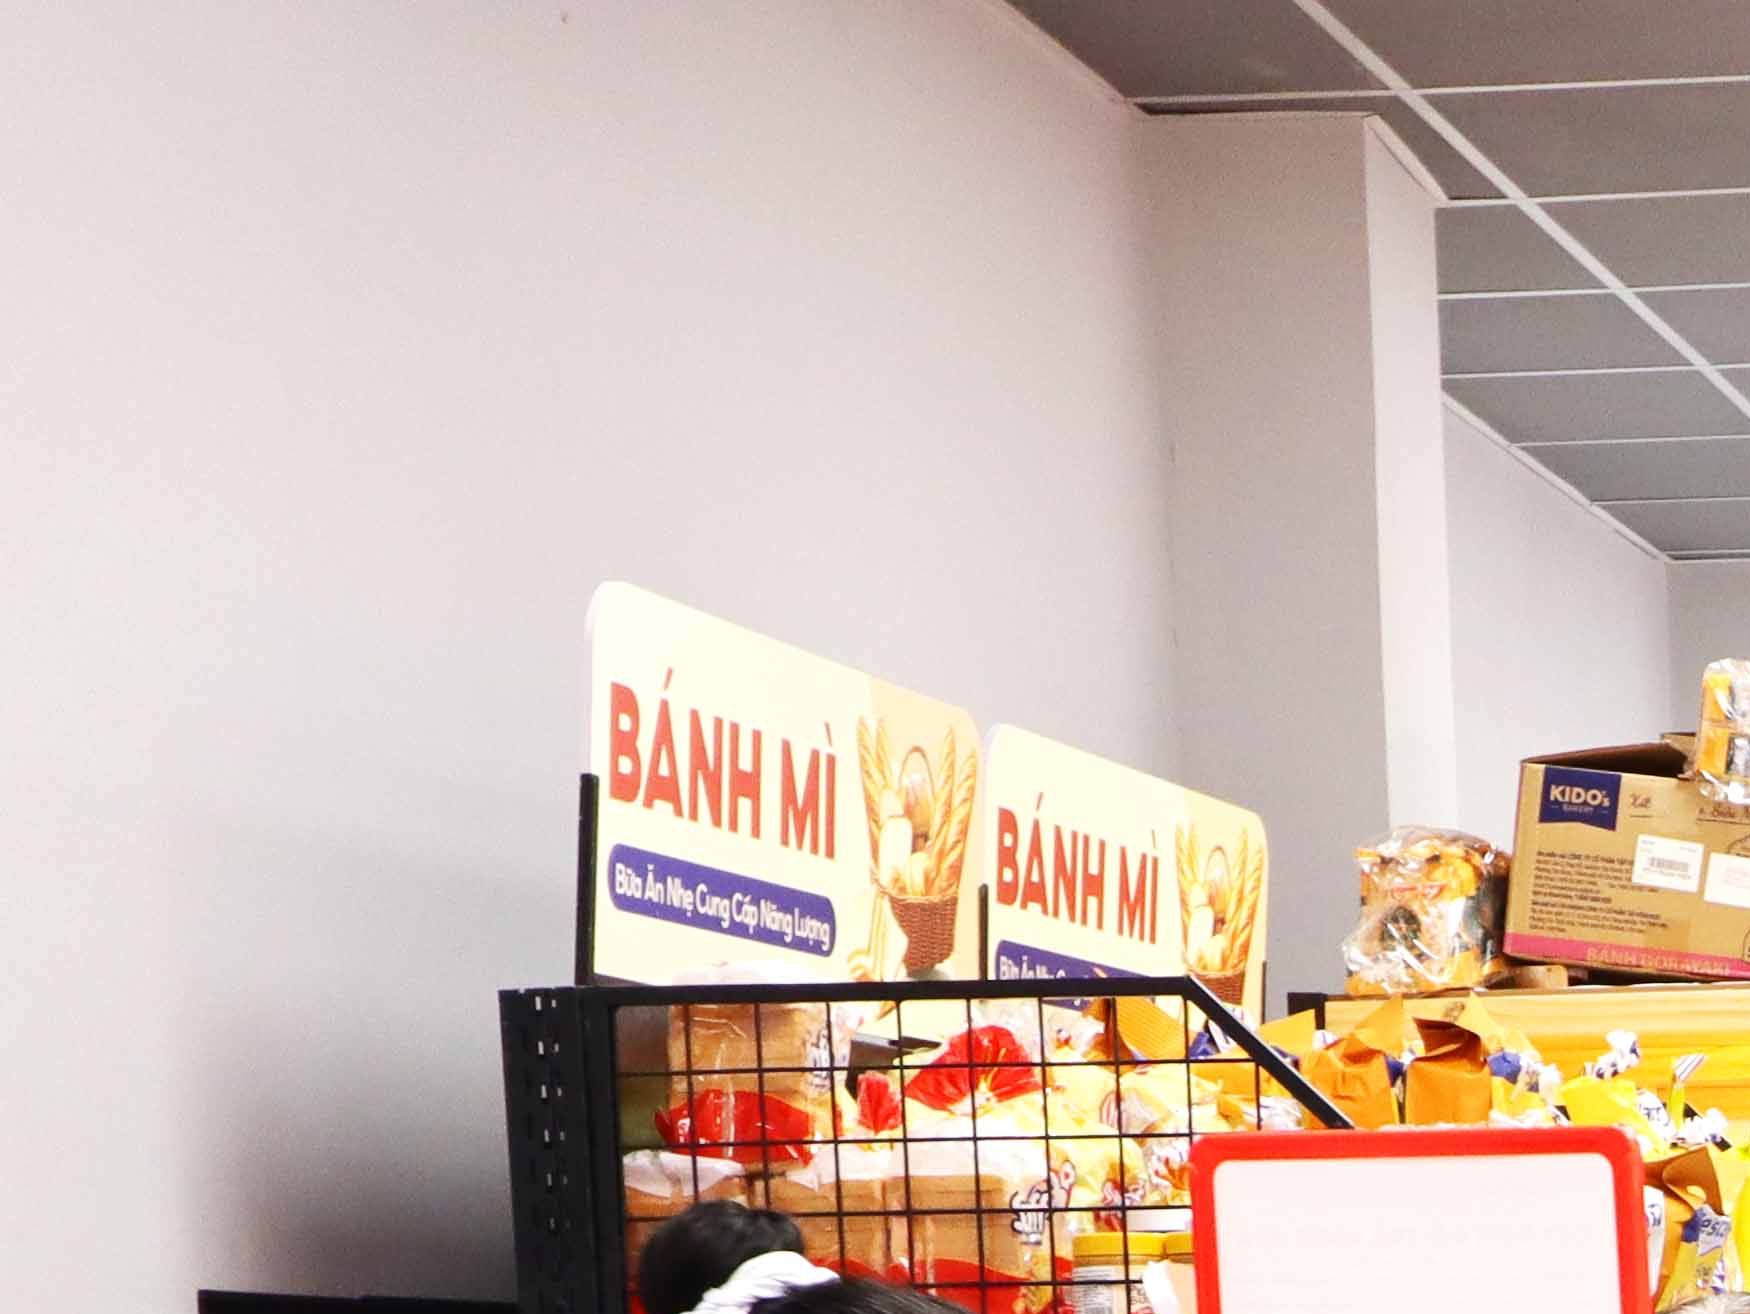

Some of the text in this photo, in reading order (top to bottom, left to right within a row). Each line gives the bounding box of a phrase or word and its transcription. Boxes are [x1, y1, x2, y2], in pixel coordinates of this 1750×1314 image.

[608, 667, 838, 861] BÁNH MÌ
[1550, 785, 1611, 807] KIDO's
[615, 862, 831, 951] Bữa Ăn Nhẹ Cung Cấp Năng Lượng
[995, 792, 1159, 944] BÁNH MÌ
